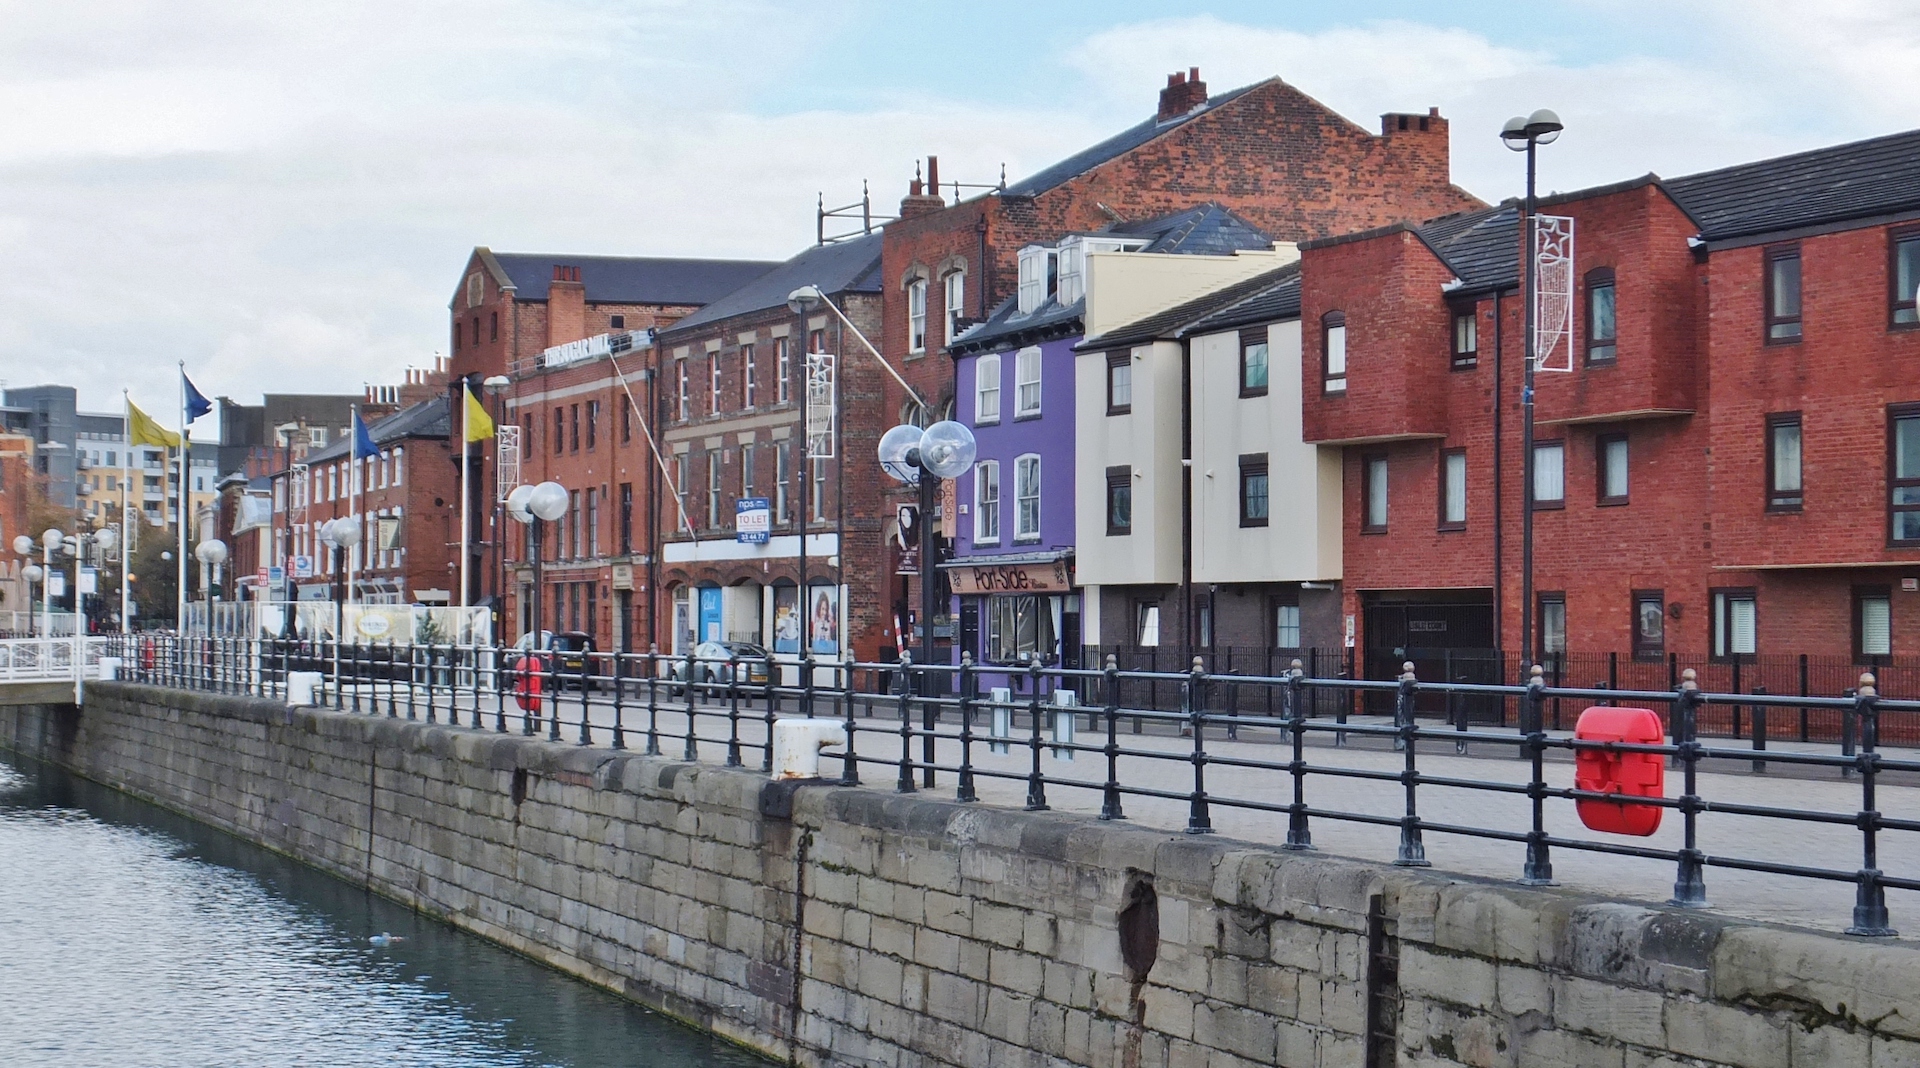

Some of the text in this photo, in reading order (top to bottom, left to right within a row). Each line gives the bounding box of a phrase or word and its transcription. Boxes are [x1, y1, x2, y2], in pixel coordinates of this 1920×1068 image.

[738, 501, 754, 510] nps
[945, 479, 954, 520] Port-Side
[739, 515, 767, 524] TO LET
[973, 565, 1028, 590] Port-Side
